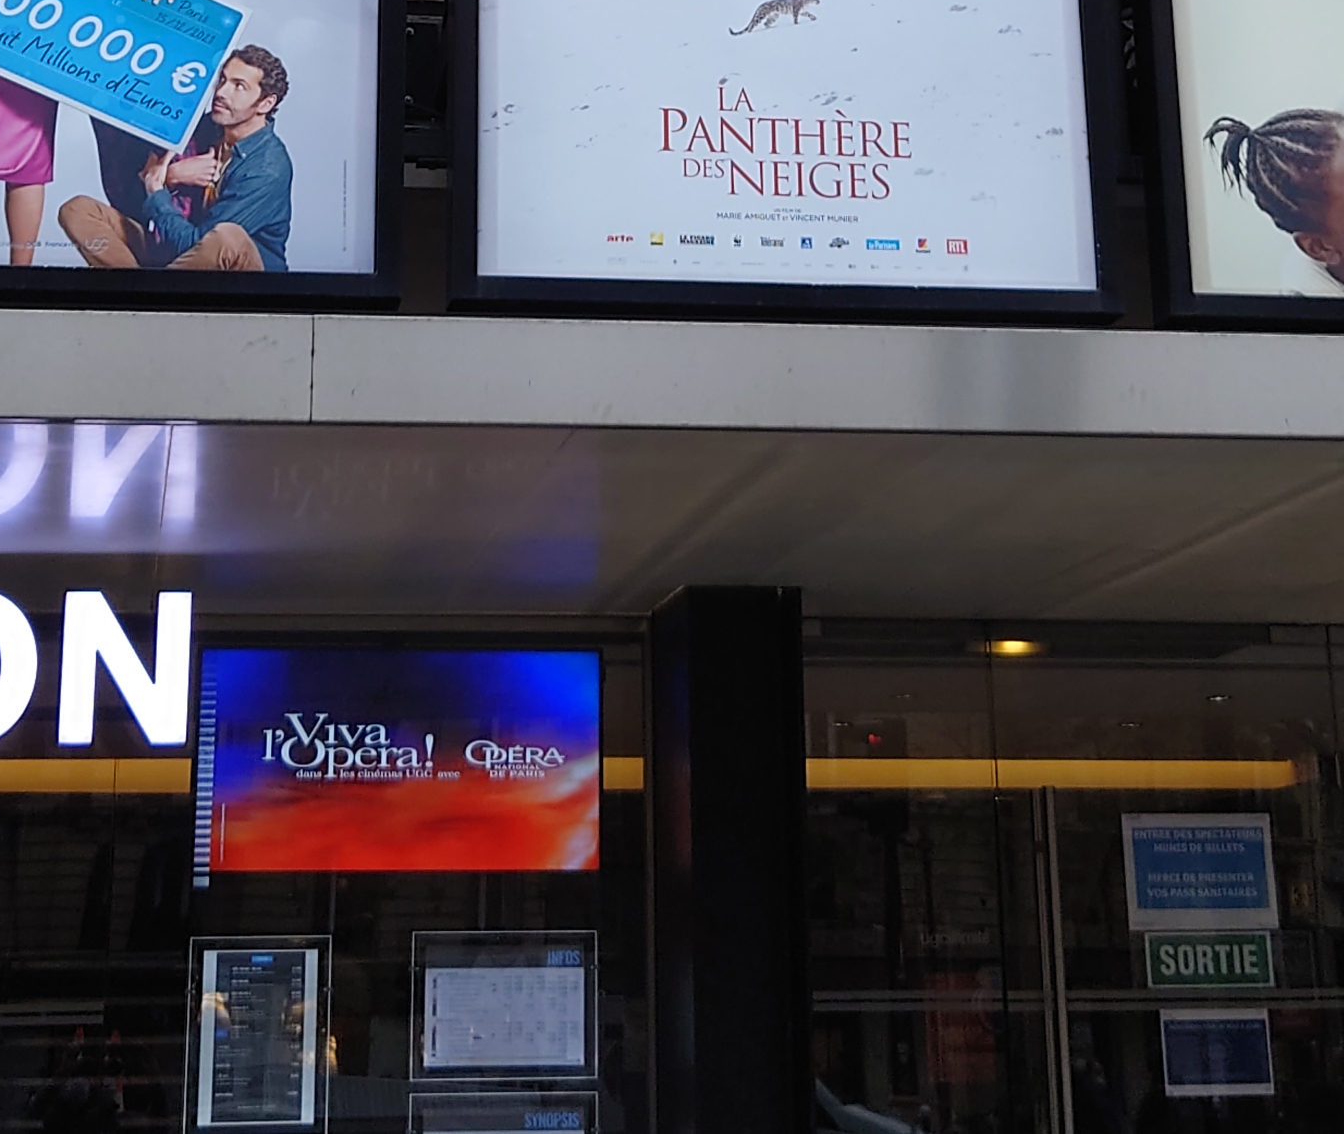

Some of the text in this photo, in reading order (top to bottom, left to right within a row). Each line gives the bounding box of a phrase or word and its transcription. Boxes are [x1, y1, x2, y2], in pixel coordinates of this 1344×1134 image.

[178, 0, 209, 23] Paris
[67, 15, 165, 76] 000
[22, 28, 102, 86] Millions
[105, 72, 184, 122] d'Euros
[717, 84, 755, 113] LA
[658, 106, 913, 159] PANTHÈRE
[683, 158, 892, 201] DES NEIGES
[716, 212, 742, 220] MARIE
[790, 214, 825, 222] VINCENT
[827, 215, 858, 223] MUNIER
[606, 234, 634, 242] arte
[948, 241, 967, 253] RTL
[284, 712, 391, 747] Viva
[296, 768, 461, 778] dans les cinémas UGC avec
[490, 770, 545, 778] DE PARIS
[1190, 842, 1202, 852] DE
[1148, 872, 1180, 882] MERCI
[1182, 872, 1194, 882] DE
[1147, 887, 1257, 898] VOS PASS SANITAIRES
[547, 949, 581, 966] INFOS
[1159, 943, 1261, 976] SORTIE
[524, 1111, 579, 1129] SYNOPSIS
